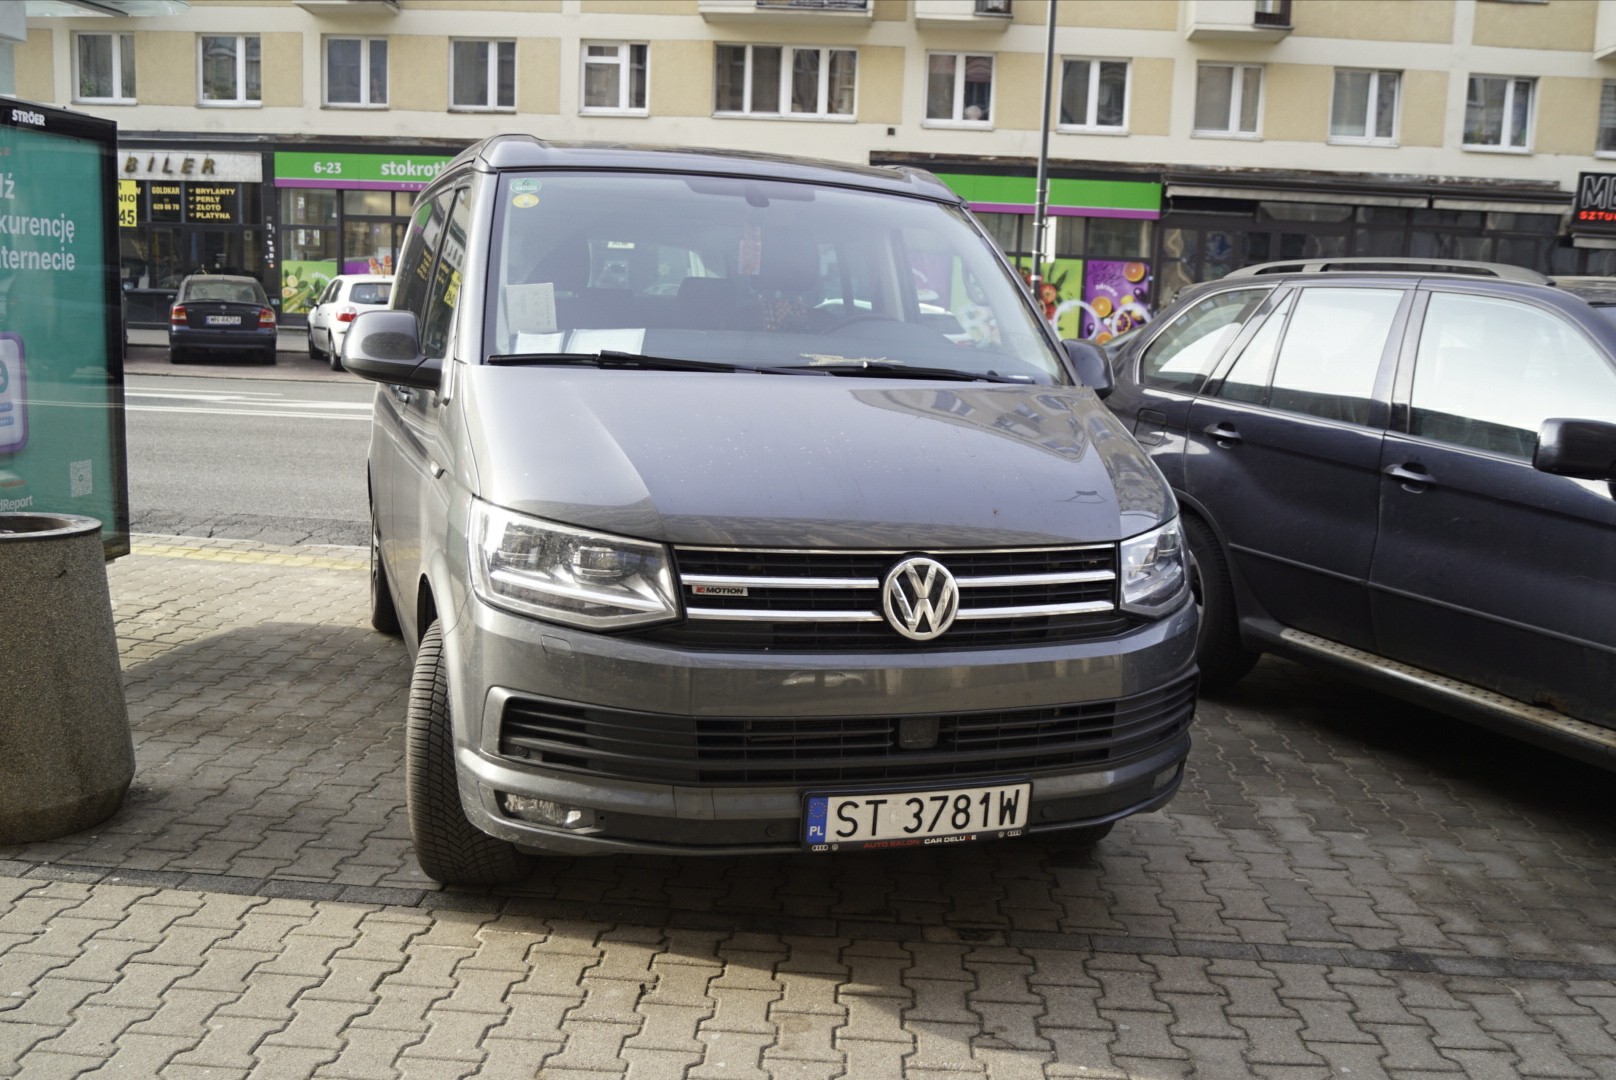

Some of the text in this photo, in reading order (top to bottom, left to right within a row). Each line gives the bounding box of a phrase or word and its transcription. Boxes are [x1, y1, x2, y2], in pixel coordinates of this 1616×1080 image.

[313, 161, 342, 174] 6-23
[0, 172, 15, 199] ź
[195, 187, 236, 195] BRYLANTY
[196, 203, 222, 211] ZŁOTO
[196, 211, 231, 219] PLATYNA
[0, 245, 75, 271] ternecie
[836, 788, 1021, 838] ST 3781W
[809, 825, 824, 837] PL
[863, 834, 977, 849] AUTO SALON CAR DELUXE
